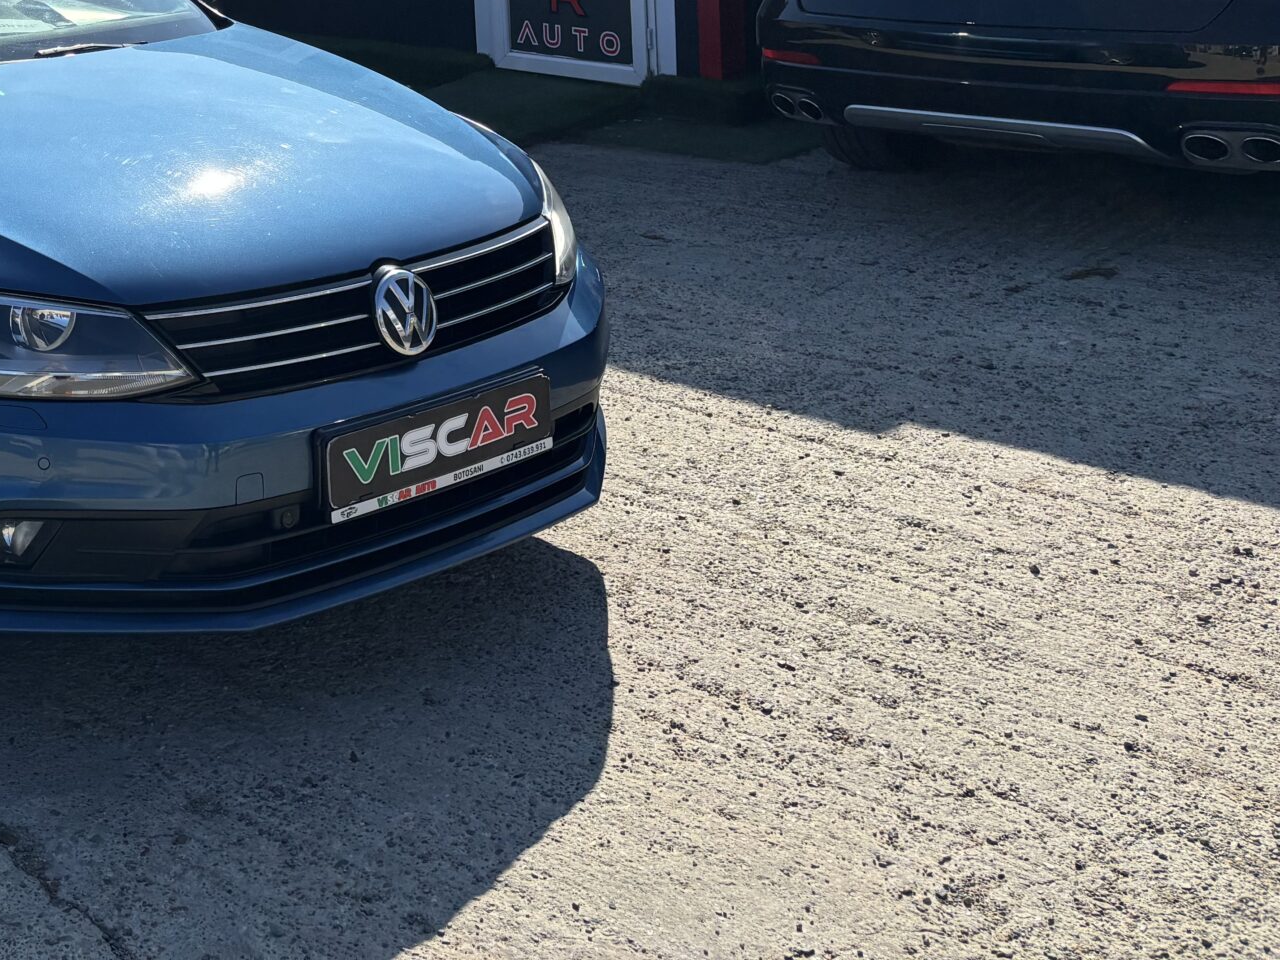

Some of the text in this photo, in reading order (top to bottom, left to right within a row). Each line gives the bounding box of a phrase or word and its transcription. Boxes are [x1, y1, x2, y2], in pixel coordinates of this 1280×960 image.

[517, 20, 621, 56] AUTO
[343, 393, 538, 484] VISCAR
[453, 464, 484, 481] BOTOSANI
[506, 442, 547, 462] 0743.639.931
